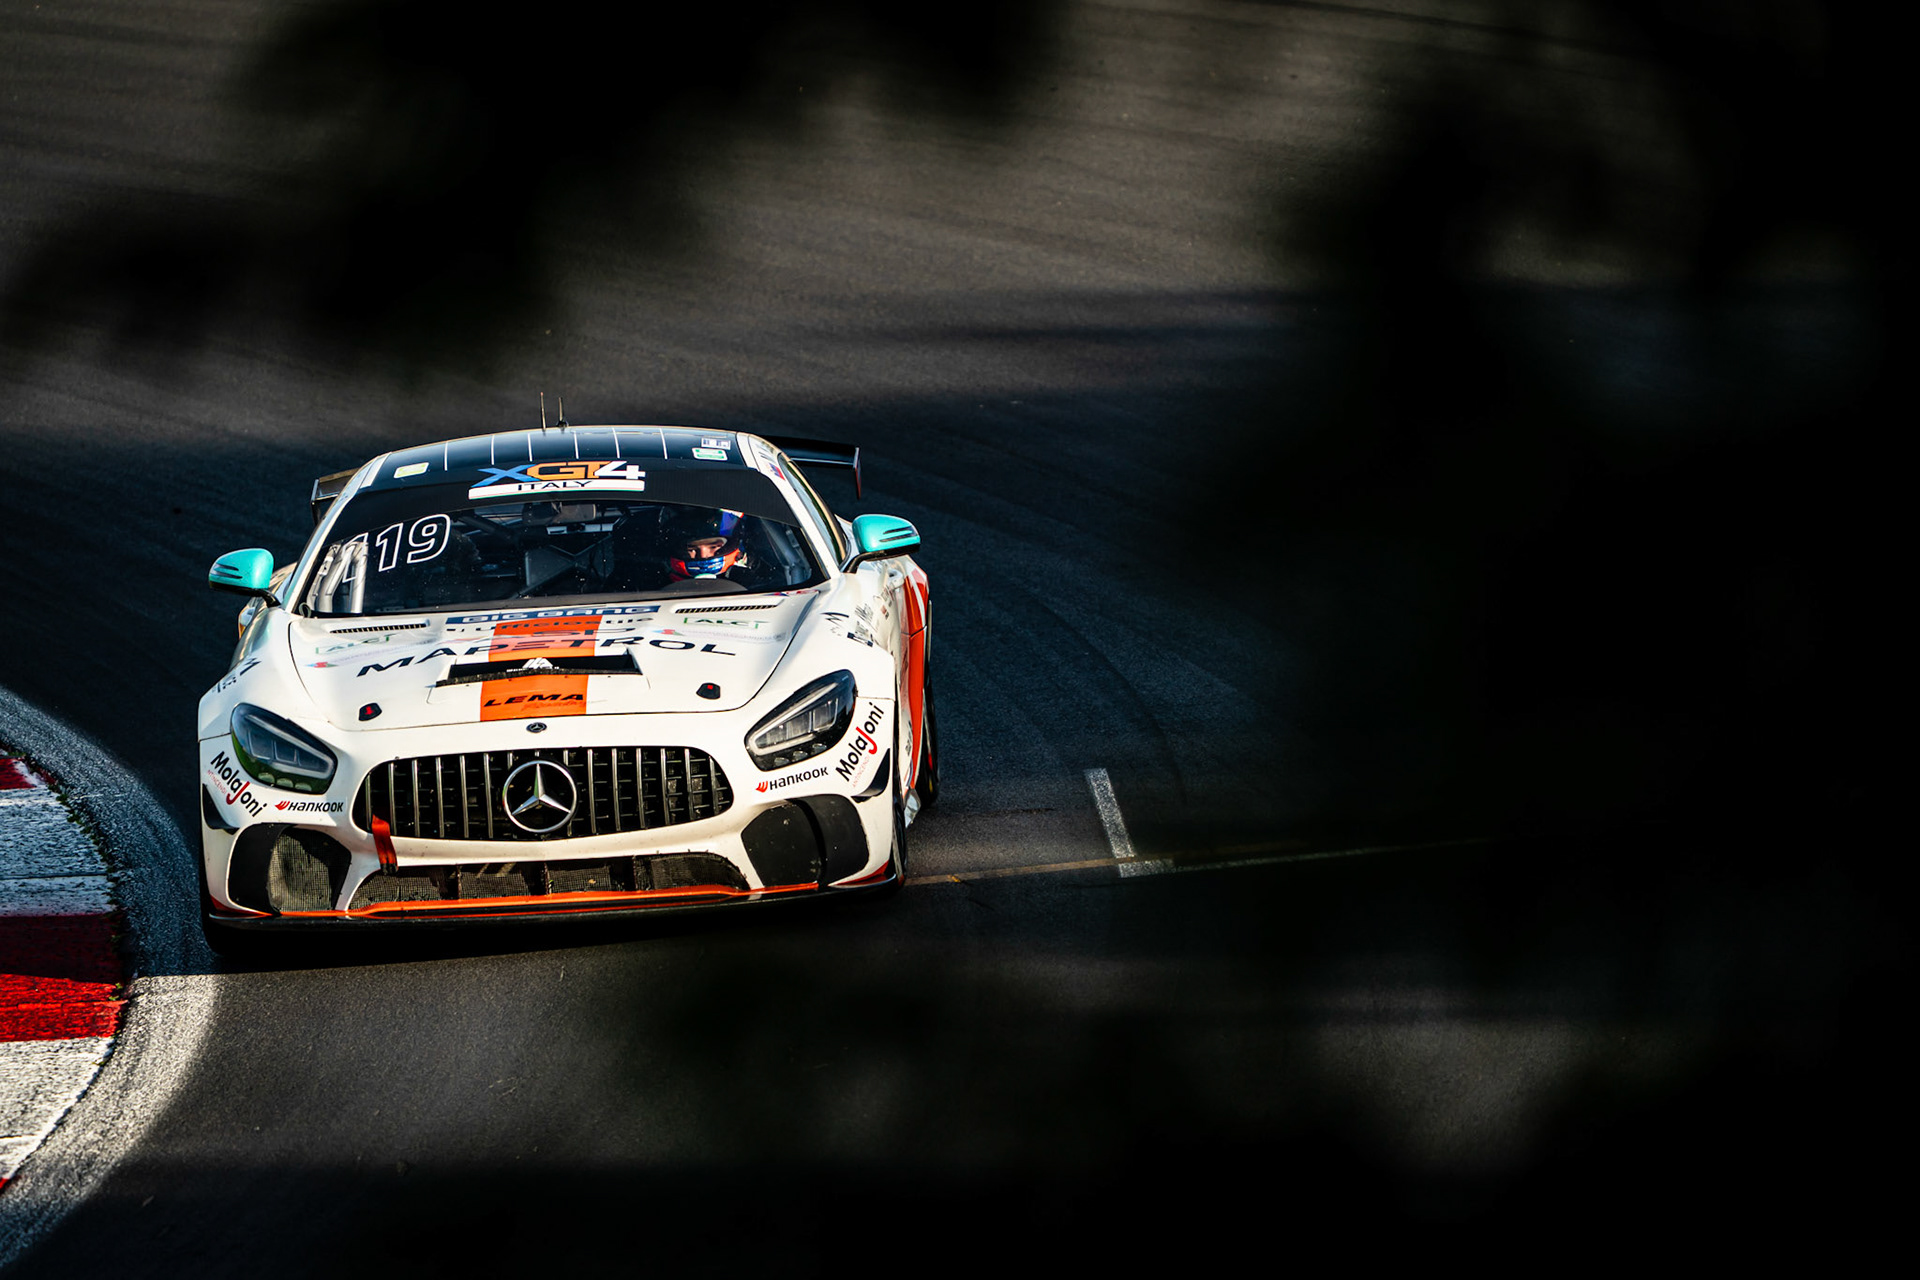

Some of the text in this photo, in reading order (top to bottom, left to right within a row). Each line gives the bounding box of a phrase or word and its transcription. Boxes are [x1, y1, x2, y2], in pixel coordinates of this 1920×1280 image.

[471, 460, 646, 488] XGT4
[518, 480, 593, 491] ITALY
[341, 513, 451, 583] 119
[461, 607, 651, 624] BIG BANG
[357, 636, 736, 677] MAPETROL
[484, 693, 584, 708] LEMA
